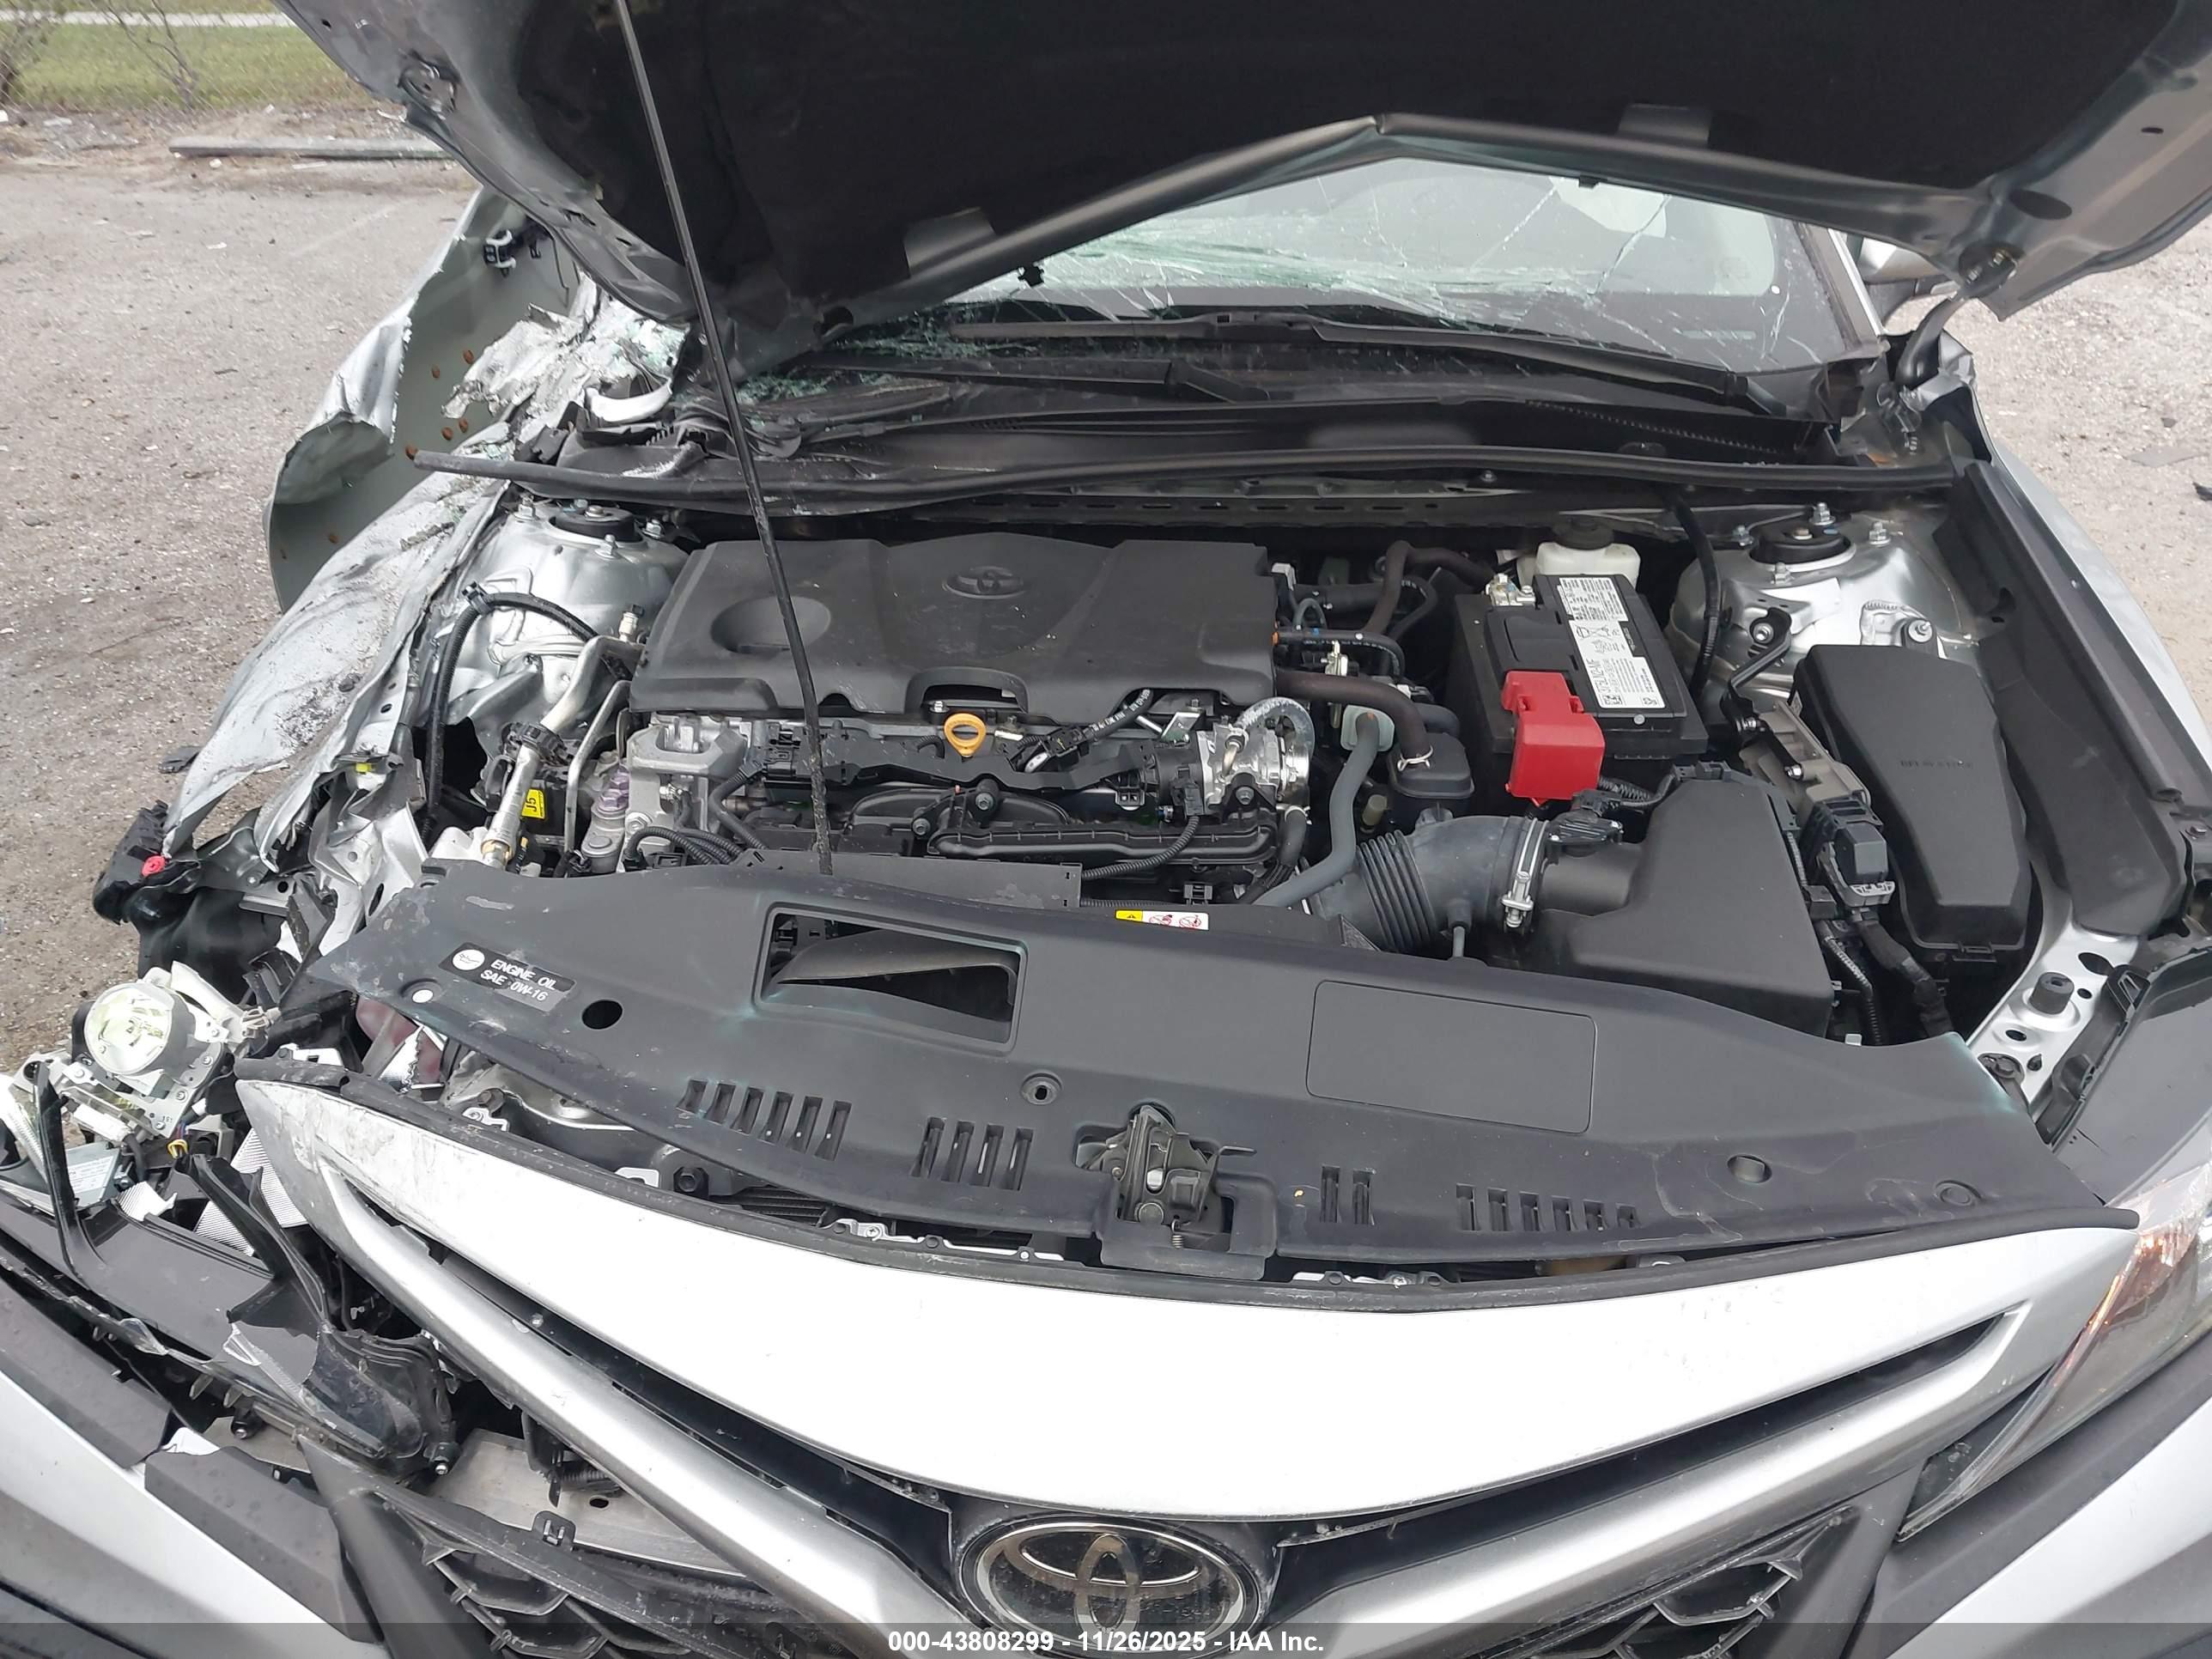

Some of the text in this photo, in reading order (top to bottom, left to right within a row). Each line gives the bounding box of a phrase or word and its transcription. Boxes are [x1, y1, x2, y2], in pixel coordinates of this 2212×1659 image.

[480, 969, 549, 1001] SAE 0W-16
[490, 958, 558, 991] ENGINE OIL
